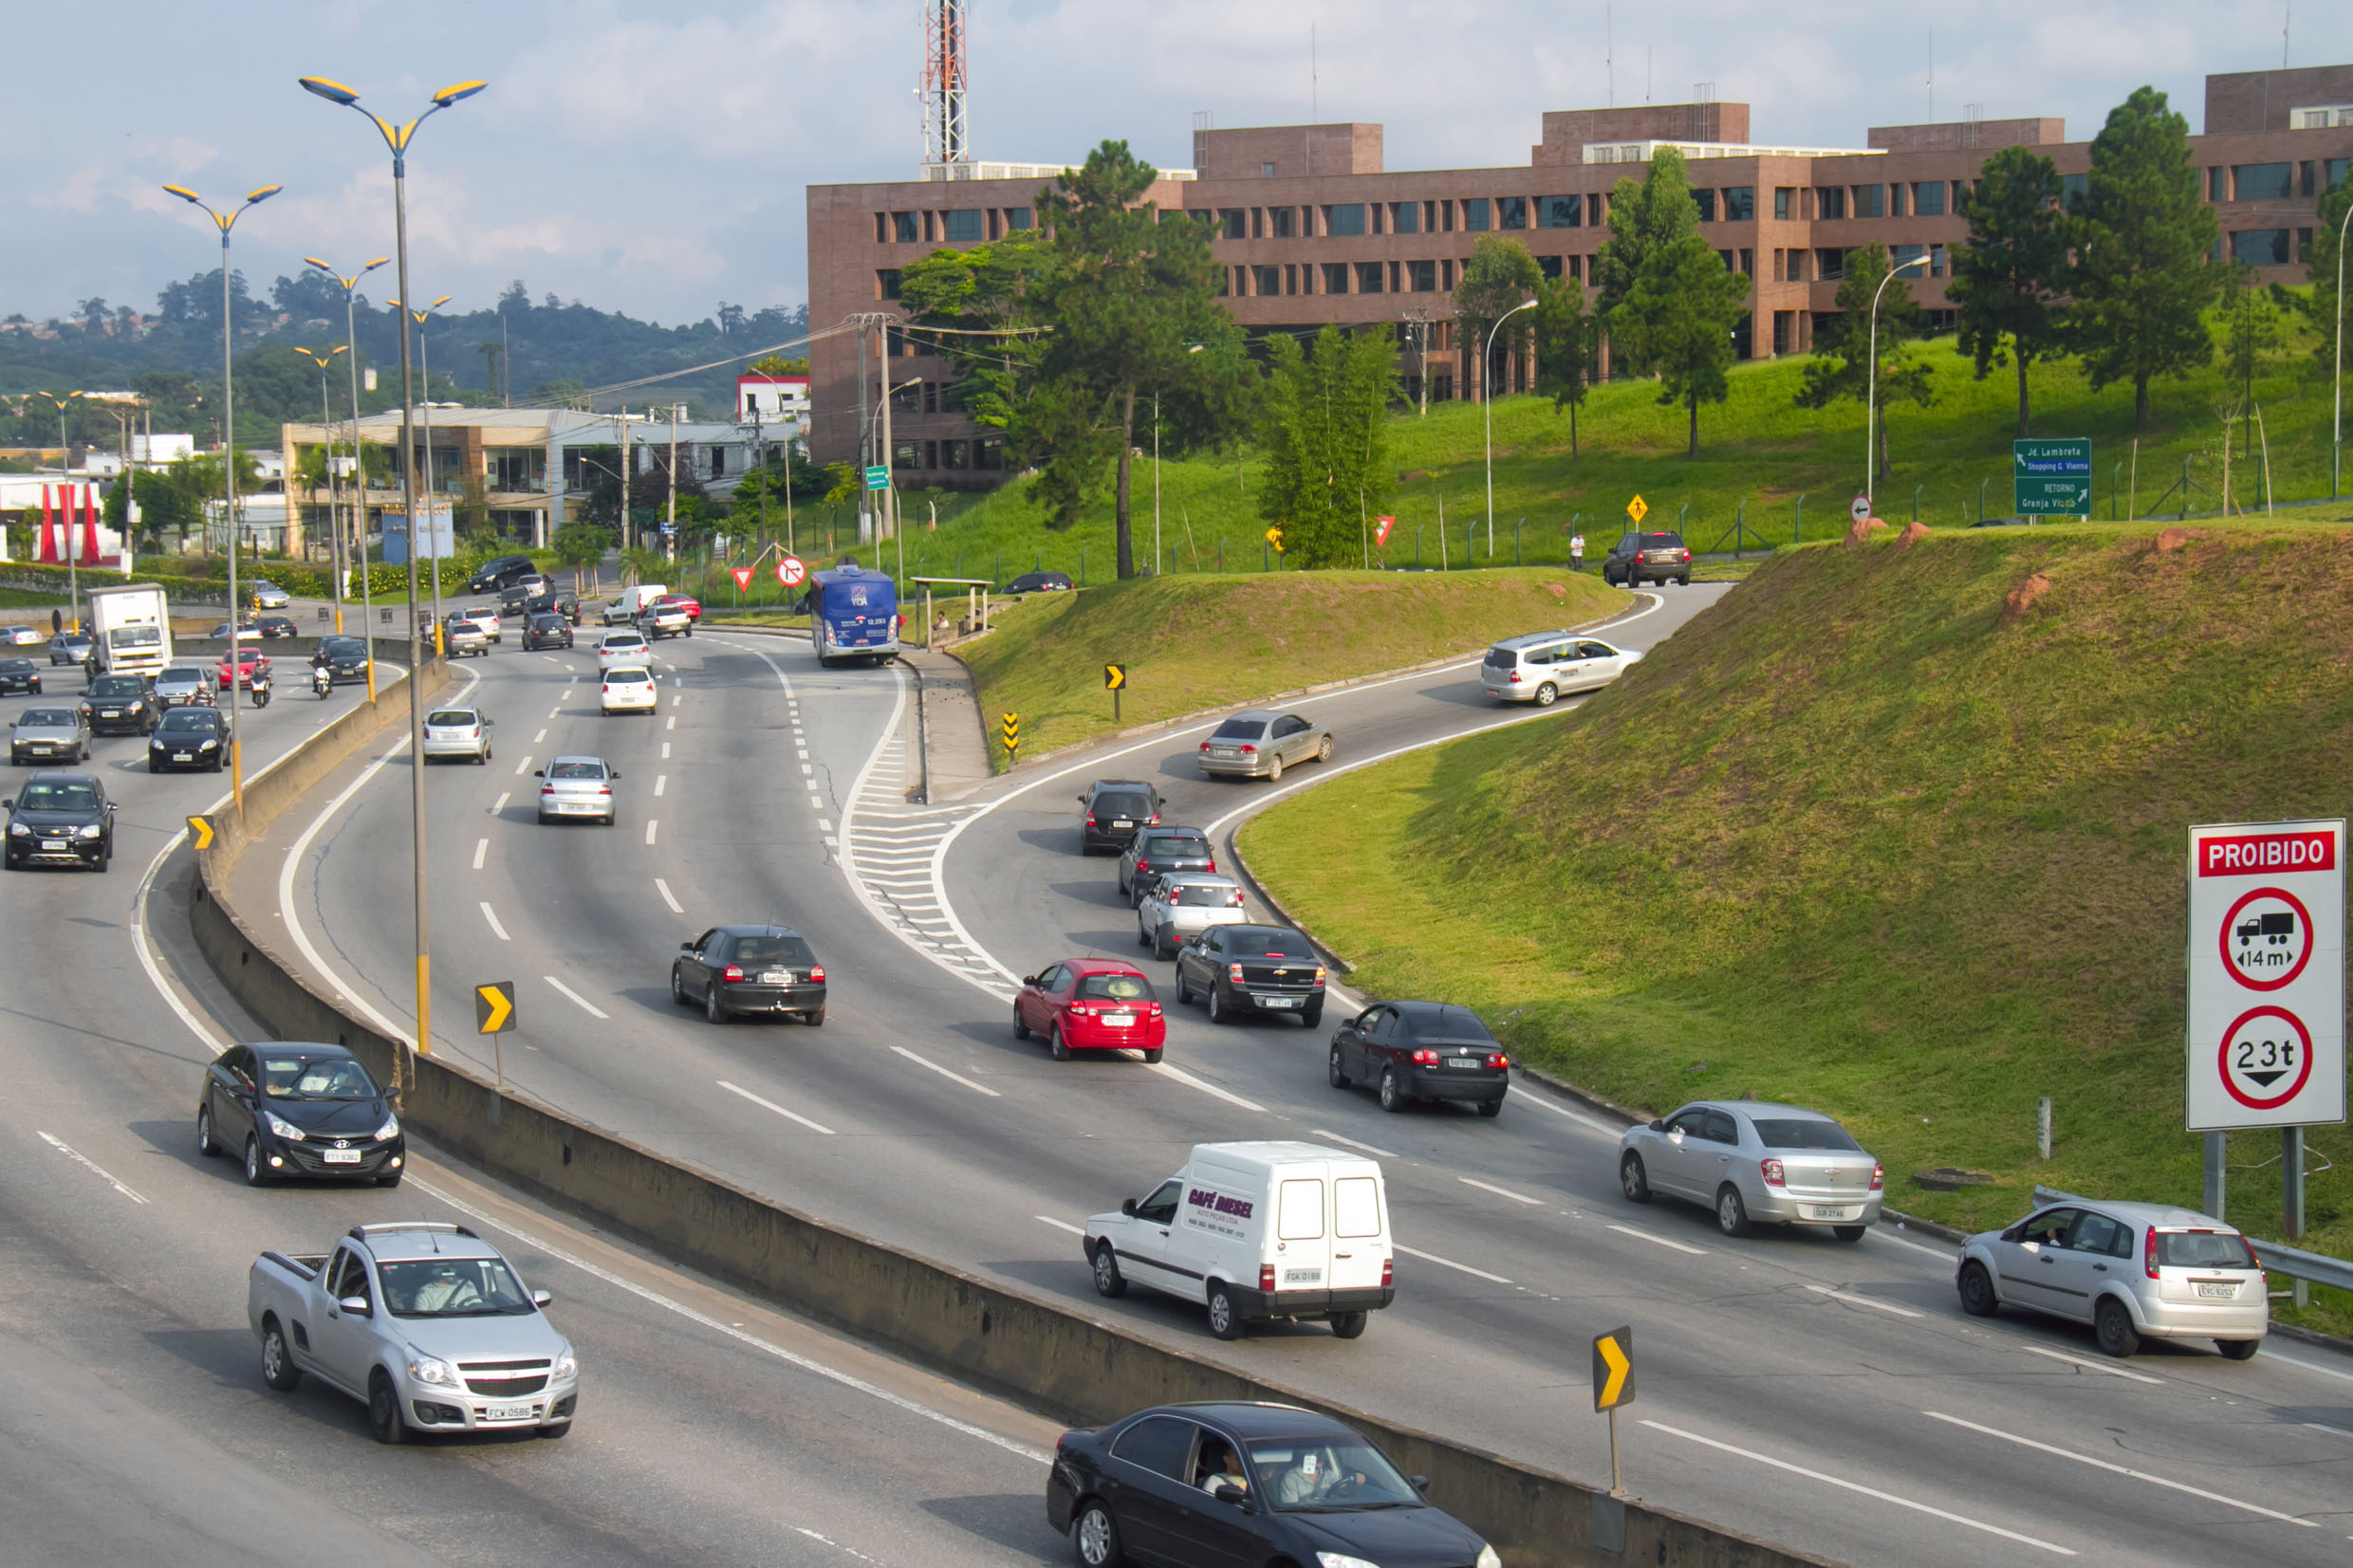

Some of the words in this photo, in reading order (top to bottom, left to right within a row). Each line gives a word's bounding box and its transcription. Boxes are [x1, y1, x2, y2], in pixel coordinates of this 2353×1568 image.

[2041, 447, 2081, 456] Lambreta
[2028, 462, 2056, 472] Shopping
[2044, 484, 2075, 493] RETORNO
[2022, 498, 2049, 509] Granja
[2209, 839, 2325, 869] PROIBIDO
[1188, 1189, 1217, 1209] CAFÉ
[1214, 1195, 1253, 1219] DIESEL
